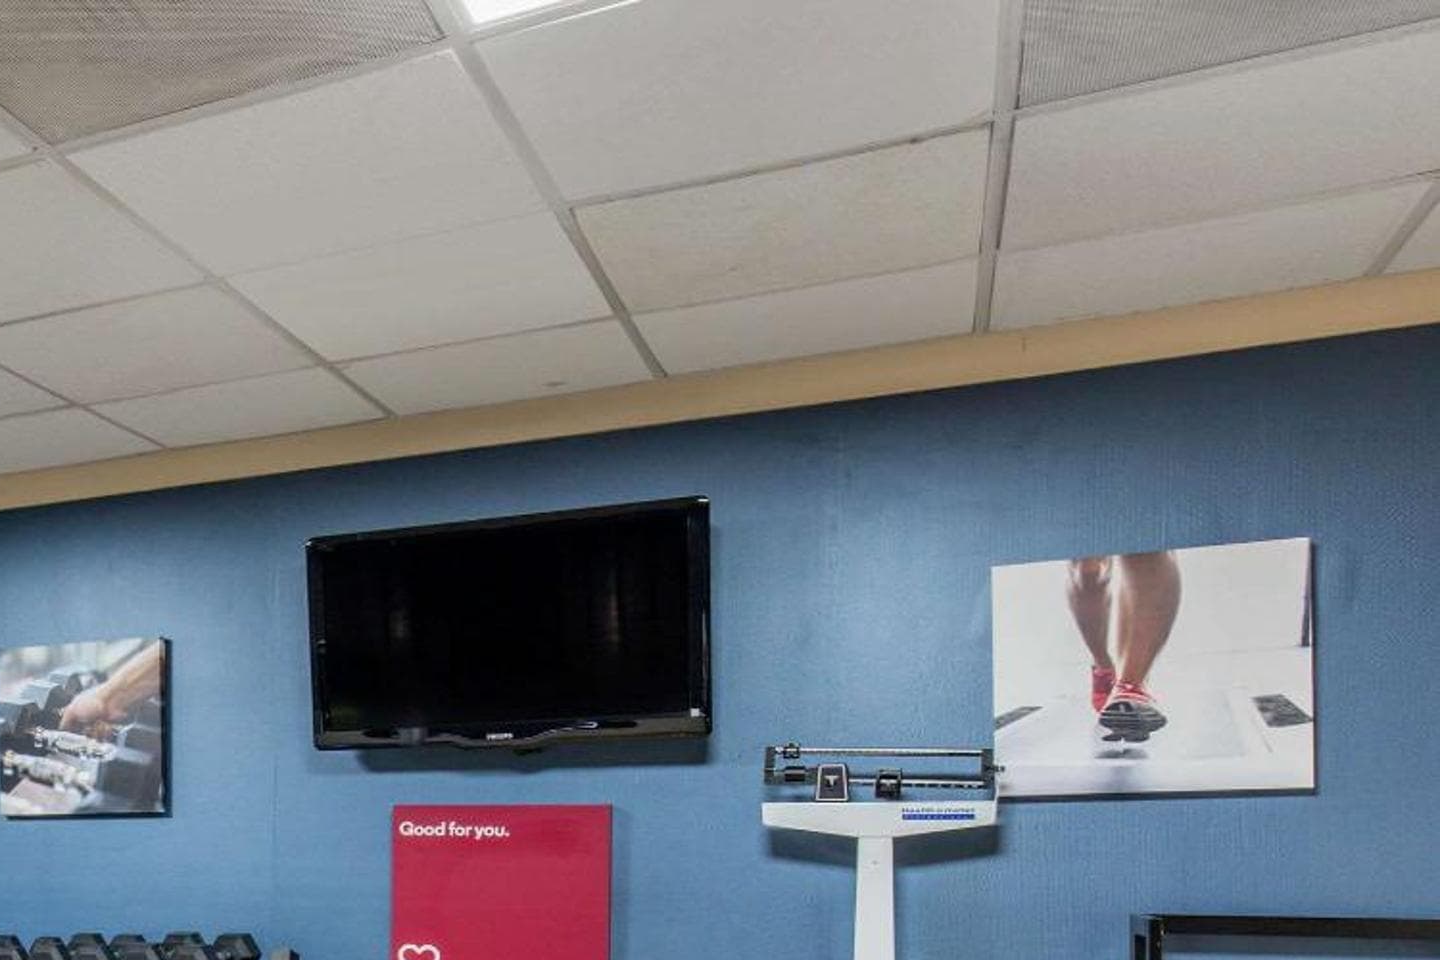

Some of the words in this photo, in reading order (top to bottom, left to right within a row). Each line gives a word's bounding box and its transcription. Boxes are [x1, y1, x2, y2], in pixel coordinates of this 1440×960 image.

[398, 821, 446, 837] Good
[448, 821, 472, 837] for
[474, 823, 510, 840] you.
